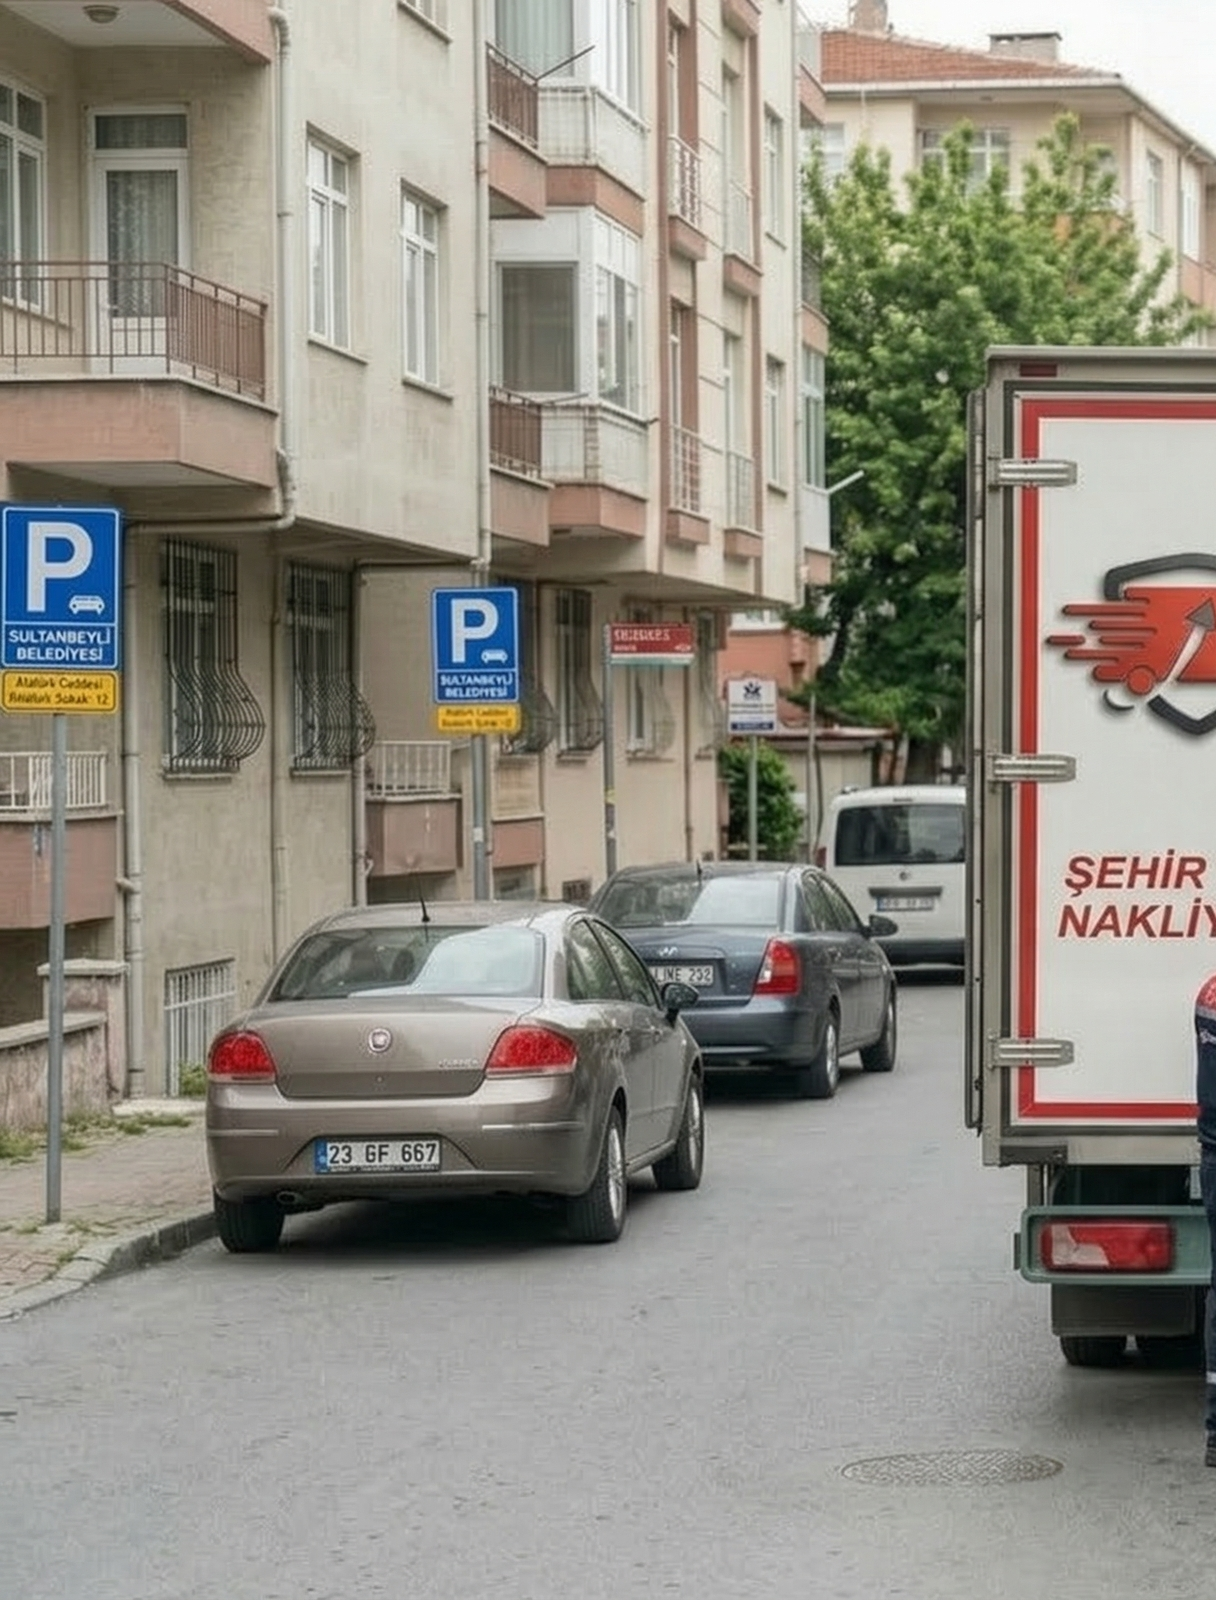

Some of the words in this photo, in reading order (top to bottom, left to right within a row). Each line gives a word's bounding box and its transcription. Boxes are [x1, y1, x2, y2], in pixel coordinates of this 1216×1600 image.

[27, 521, 93, 612] P
[9, 627, 111, 645] SULTANBEYLİ
[451, 598, 499, 663] P
[16, 646, 103, 661] BELEDİYESİ
[1064, 848, 1207, 898] ŞEHİR
[329, 1144, 353, 1165] 23
[365, 1143, 390, 1164] GF
[401, 1142, 437, 1163] 667
